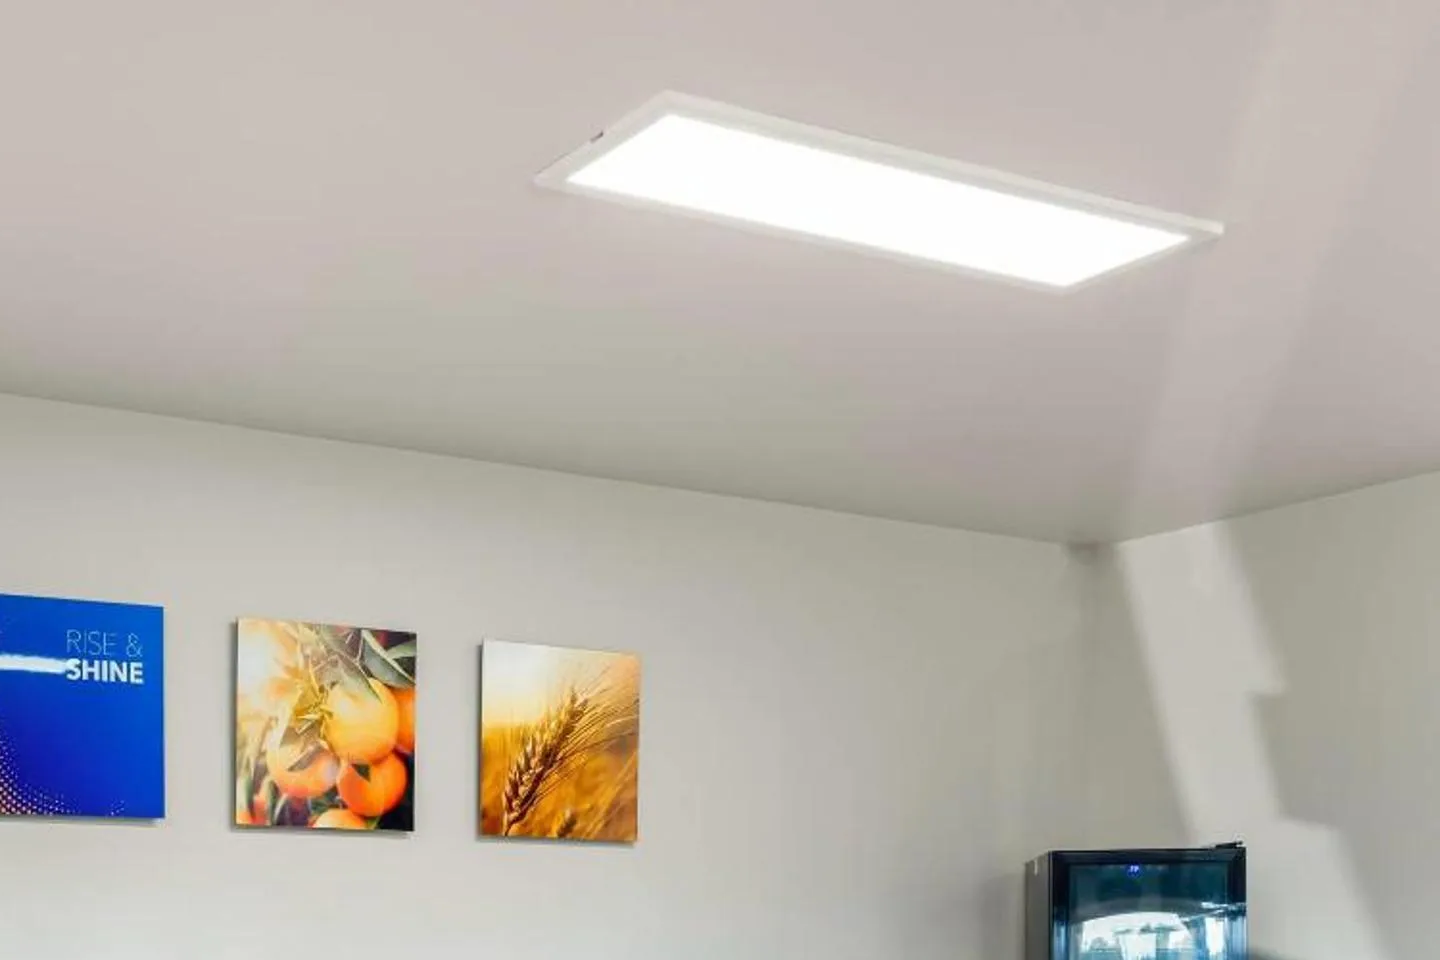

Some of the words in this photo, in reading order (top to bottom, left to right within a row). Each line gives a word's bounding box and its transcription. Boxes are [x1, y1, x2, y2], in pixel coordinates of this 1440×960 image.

[66, 629, 117, 656] RISE
[126, 633, 143, 657] &
[66, 658, 144, 684] SHINE
